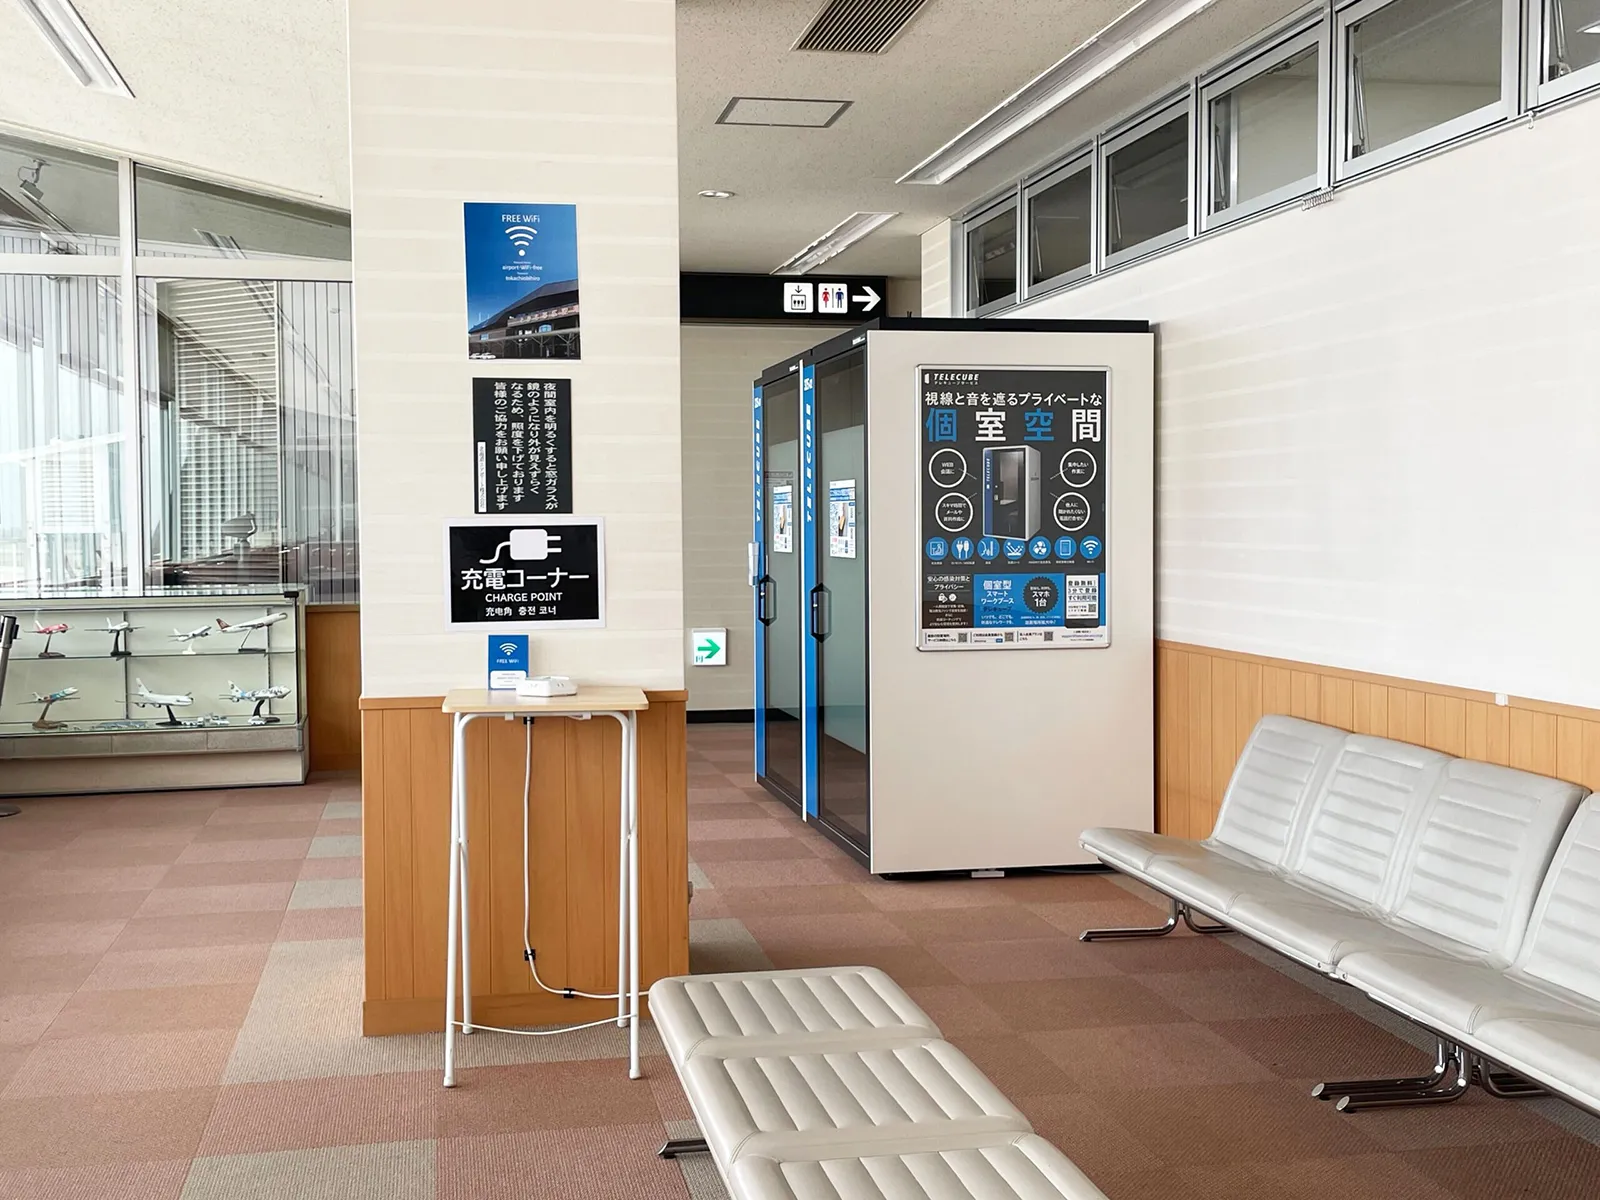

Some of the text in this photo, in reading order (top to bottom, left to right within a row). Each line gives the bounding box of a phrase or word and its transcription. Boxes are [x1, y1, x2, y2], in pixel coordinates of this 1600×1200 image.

[501, 214, 540, 223] FREE WiFi
[924, 392, 1102, 406] 視線と音を遮るプライベートな
[926, 407, 1102, 442] 個室空間
[494, 382, 508, 510] 皆様のご協力をお願い申し上げます
[510, 382, 525, 502] なるため、照度を下げております
[544, 382, 558, 510] 夜間室内を明るくすると窓ガラスが
[460, 566, 590, 590] 充電コーナー
[983, 580, 1012, 590] 個室型
[485, 592, 563, 602] CHARGE POINT
[1034, 598, 1047, 607] 1台
[486, 606, 512, 616] 充电角
[518, 606, 557, 616] 충전 코너
